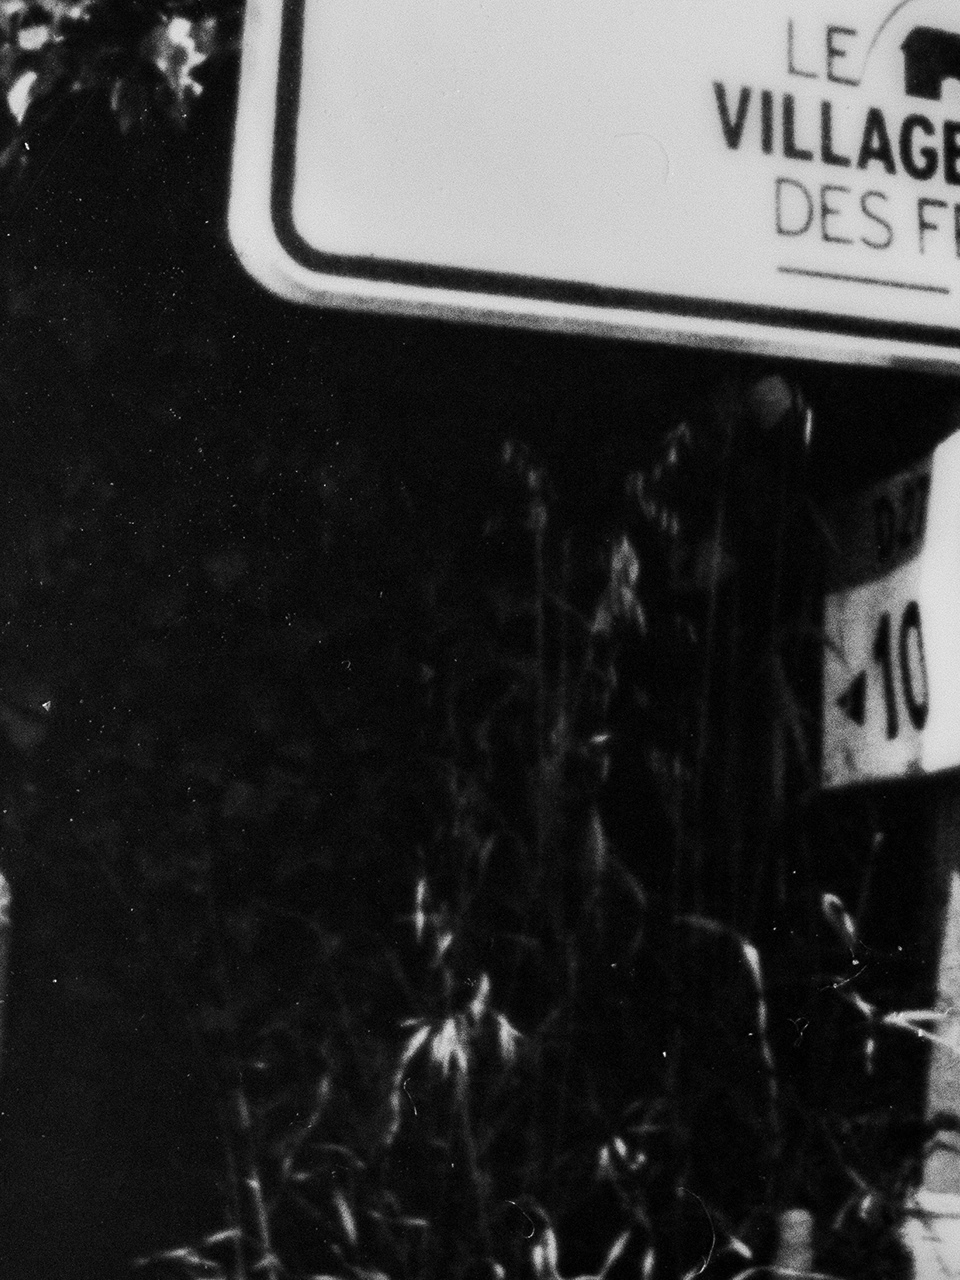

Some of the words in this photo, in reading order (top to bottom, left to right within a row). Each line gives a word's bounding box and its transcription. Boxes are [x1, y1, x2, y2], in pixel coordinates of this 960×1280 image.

[786, 17, 860, 87] LE
[774, 176, 894, 250] DES
[873, 600, 930, 742] 10
